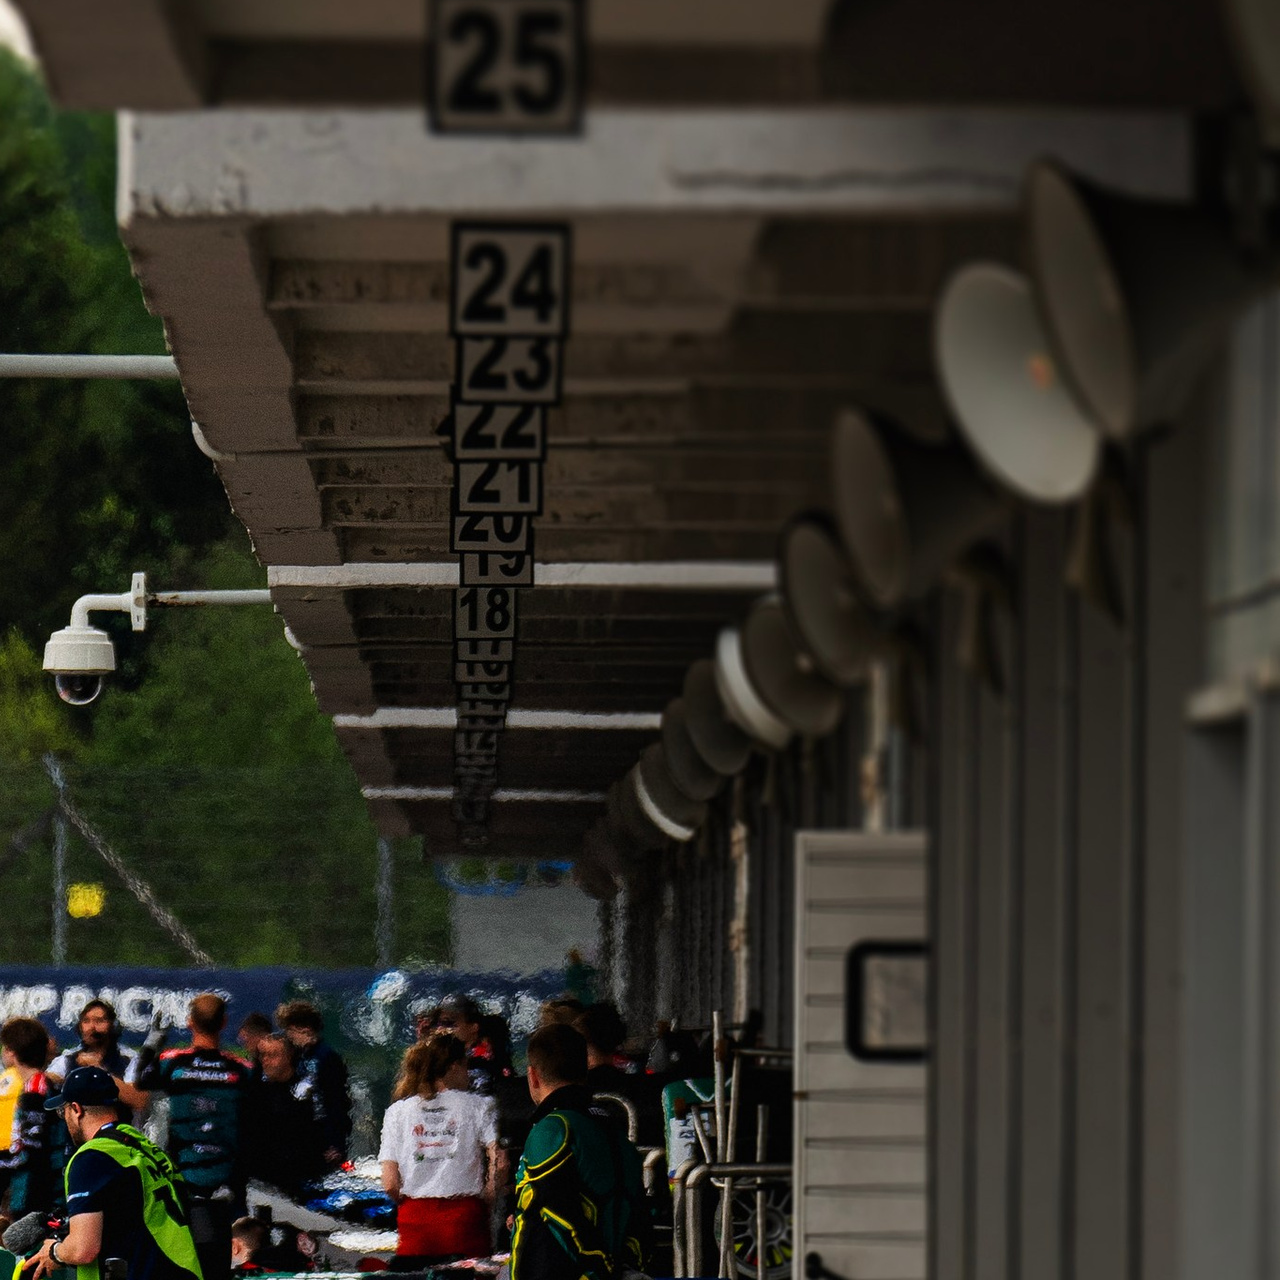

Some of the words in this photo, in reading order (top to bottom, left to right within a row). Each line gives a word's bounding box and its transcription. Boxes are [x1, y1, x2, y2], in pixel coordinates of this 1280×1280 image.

[448, 9, 565, 116] 25
[462, 242, 558, 323] 24
[467, 337, 552, 391] 23
[460, 405, 537, 449] 22
[467, 463, 531, 503] 21
[460, 588, 511, 632] 18
